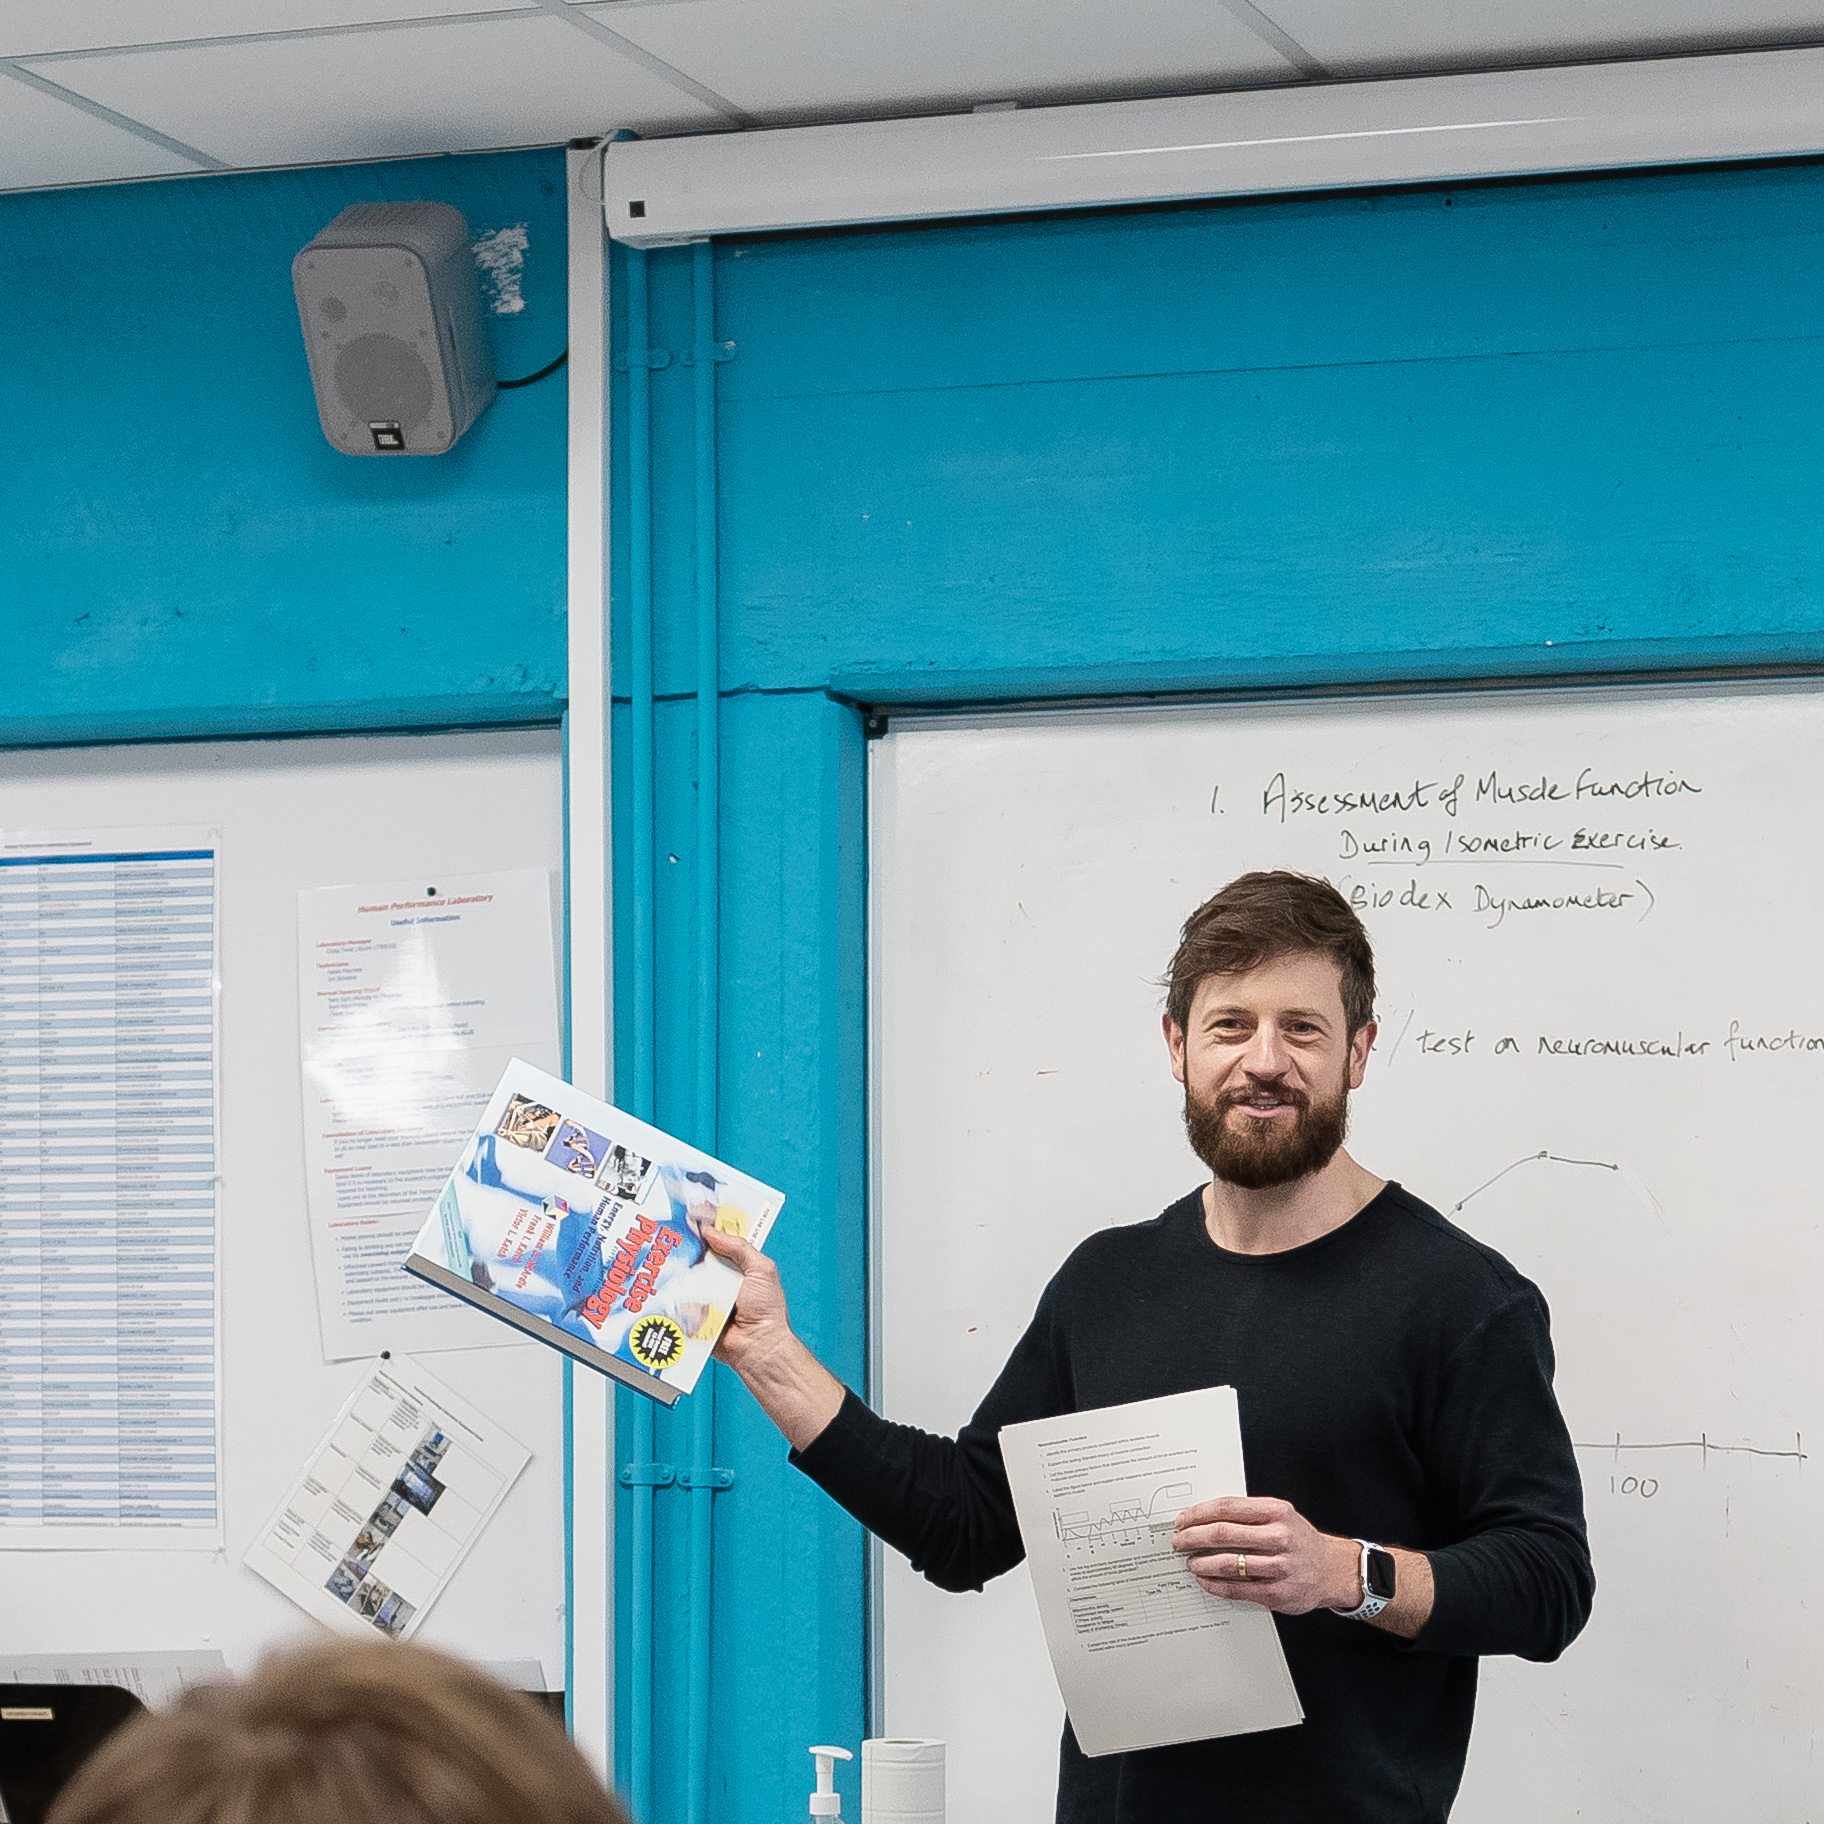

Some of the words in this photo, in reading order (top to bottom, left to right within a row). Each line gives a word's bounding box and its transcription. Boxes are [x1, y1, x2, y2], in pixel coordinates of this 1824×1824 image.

[1262, 772, 1436, 823] Assessment
[1438, 774, 1466, 816] of
[1474, 770, 1572, 804] Muscle
[1339, 829, 1433, 866] During
[1443, 829, 1564, 854] Isometric
[1415, 1028, 1476, 1055] test
[1494, 1036, 1521, 1055] on
[1537, 1030, 1712, 1059] neuromuscular
[511, 1208, 529, 1230] Victor
[525, 1214, 543, 1236] Frank
[591, 1195, 612, 1226] Human
[600, 1201, 624, 1232] Energy,
[563, 1225, 597, 1280] Performance
[572, 1274, 585, 1295] and
[581, 1213, 660, 1331] Physiology
[623, 1225, 685, 1314] Exercise
[1609, 1474, 1659, 1500] 100
